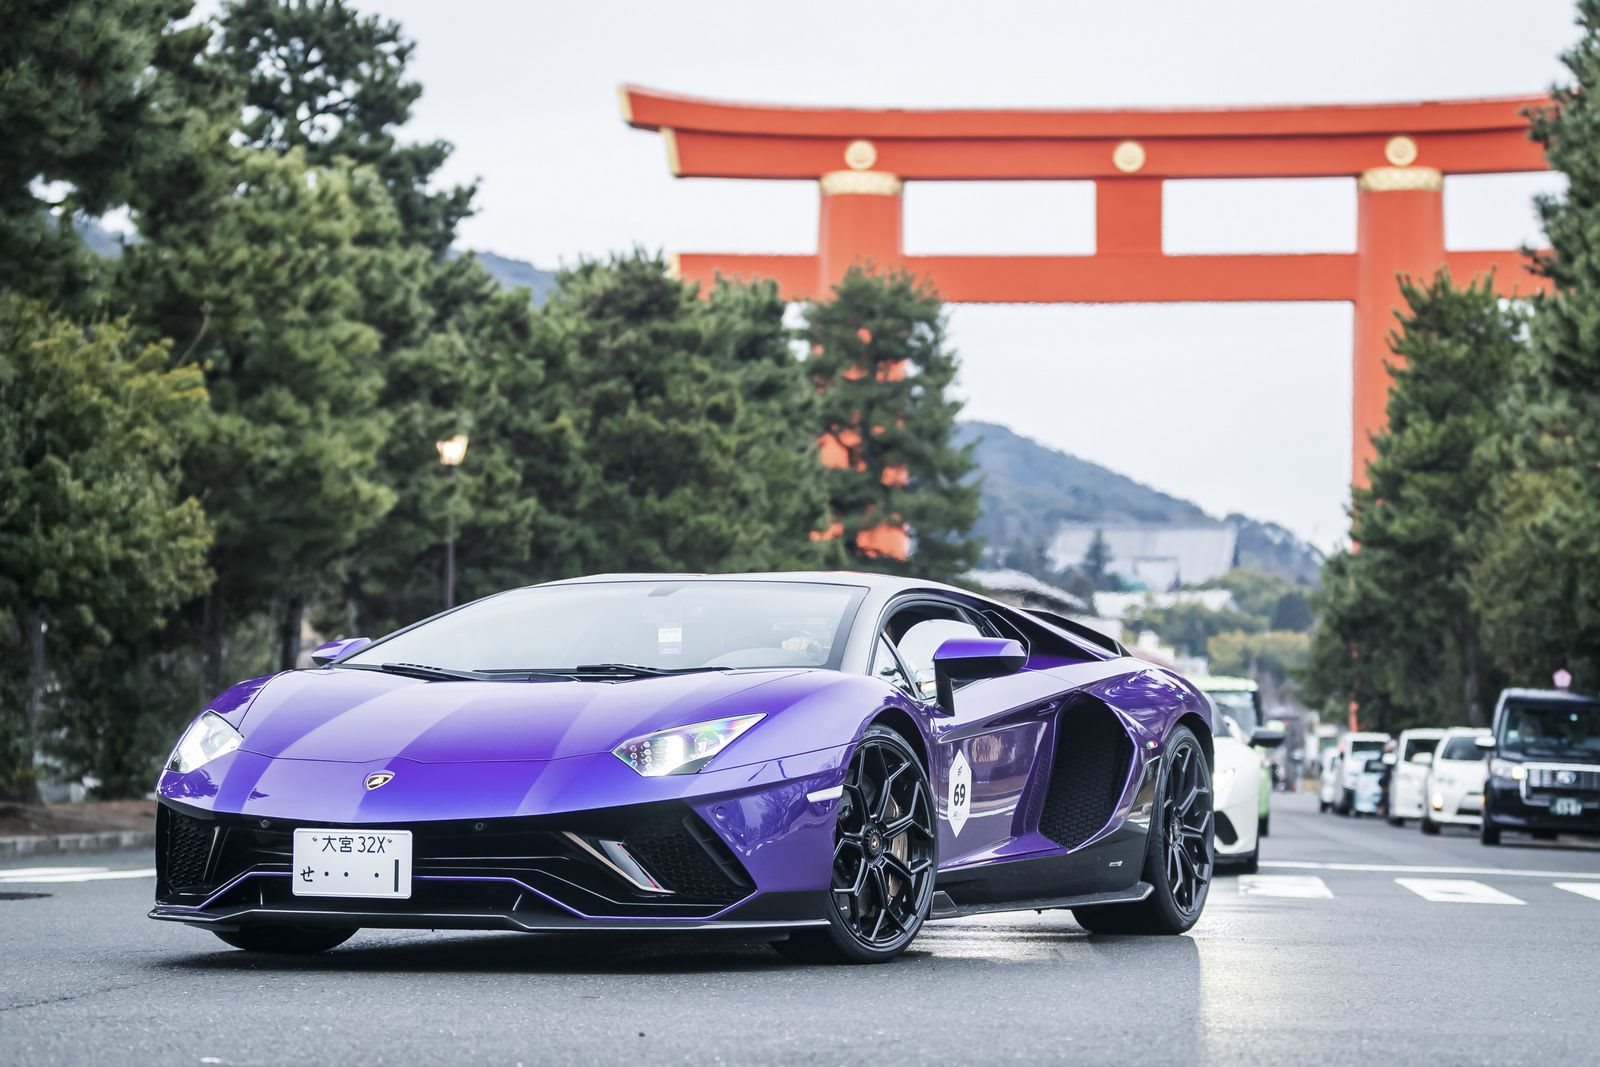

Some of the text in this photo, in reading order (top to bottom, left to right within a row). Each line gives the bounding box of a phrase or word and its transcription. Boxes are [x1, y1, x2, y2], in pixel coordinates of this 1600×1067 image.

[953, 783, 966, 807] 69
[321, 835, 386, 854] 大宮 32X
